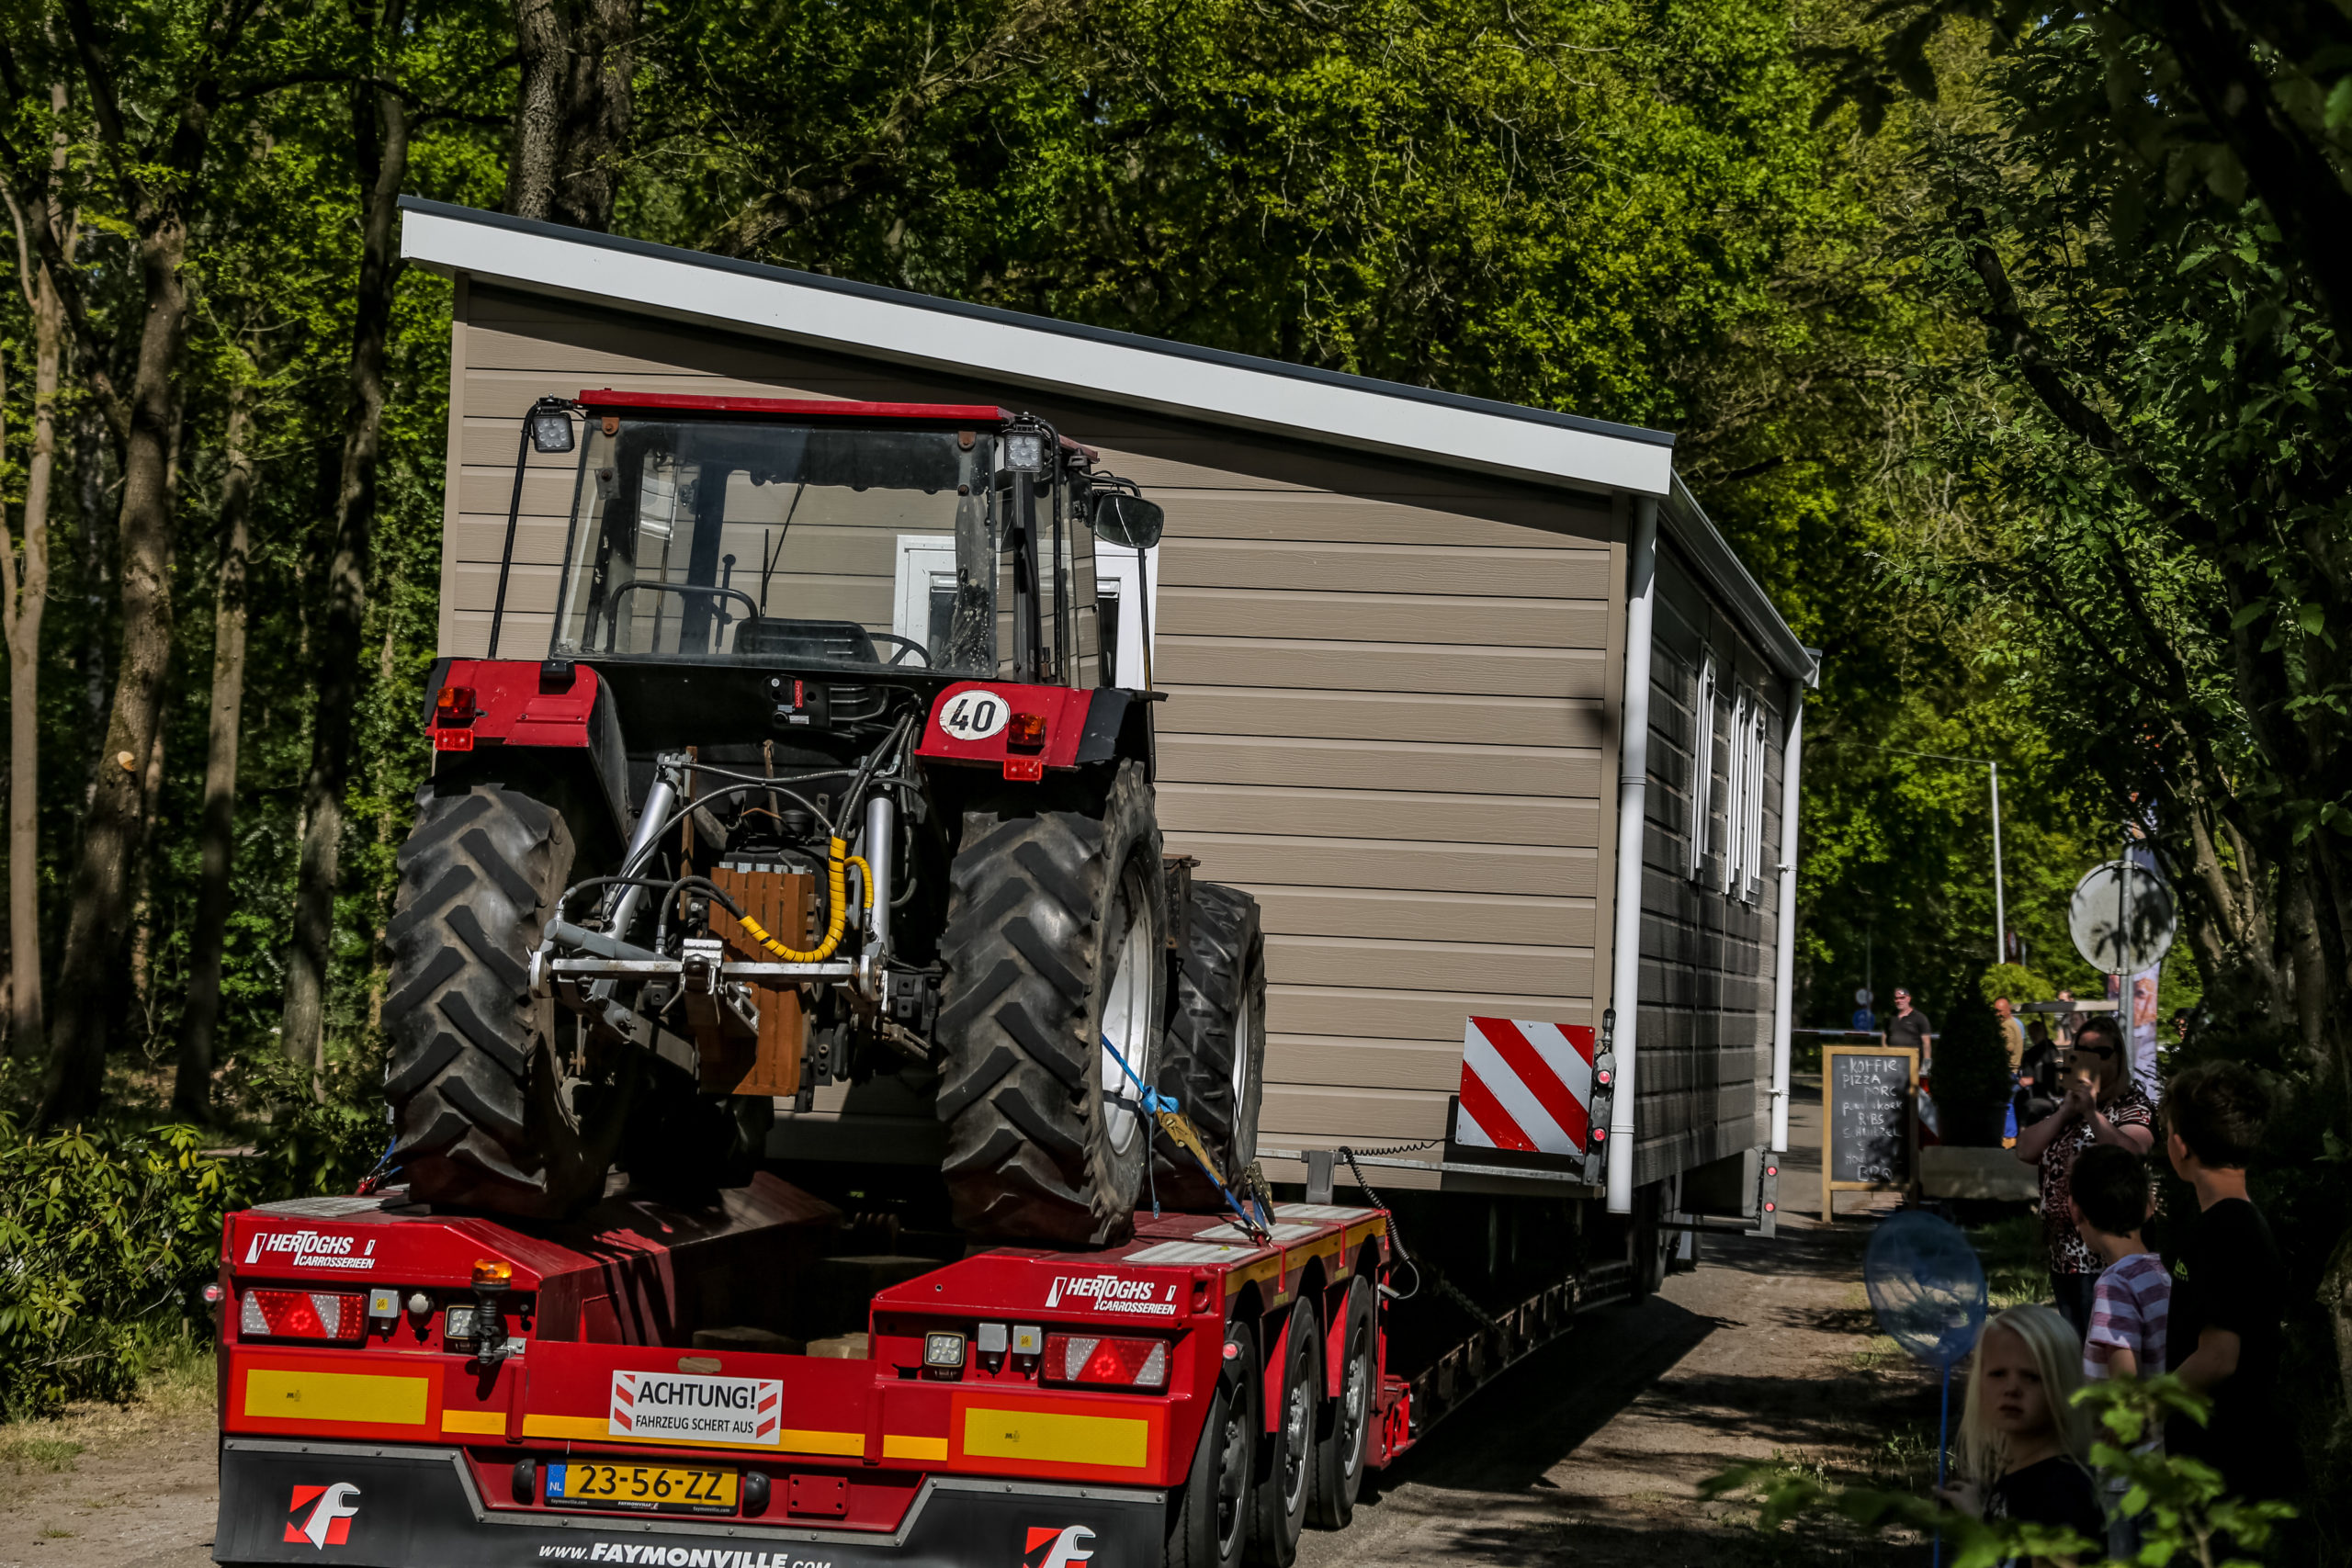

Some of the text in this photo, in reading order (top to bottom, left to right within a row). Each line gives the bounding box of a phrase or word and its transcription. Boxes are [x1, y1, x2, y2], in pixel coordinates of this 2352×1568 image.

[949, 698, 997, 733] 40
[1842, 1073, 1881, 1089] PIZZA
[266, 1230, 355, 1266] HERTOGHS
[299, 1255, 375, 1269] CARROSSERIEEN
[1066, 1274, 1155, 1310] HERTOGHS
[1099, 1300, 1177, 1315] CARROSSERIEEN
[638, 1381, 756, 1410] ACHTUNG!
[636, 1415, 753, 1434] FAHRZEUG SCHERT AUS
[549, 1482, 562, 1493] NL
[579, 1464, 723, 1501] 23-56-ZZ
